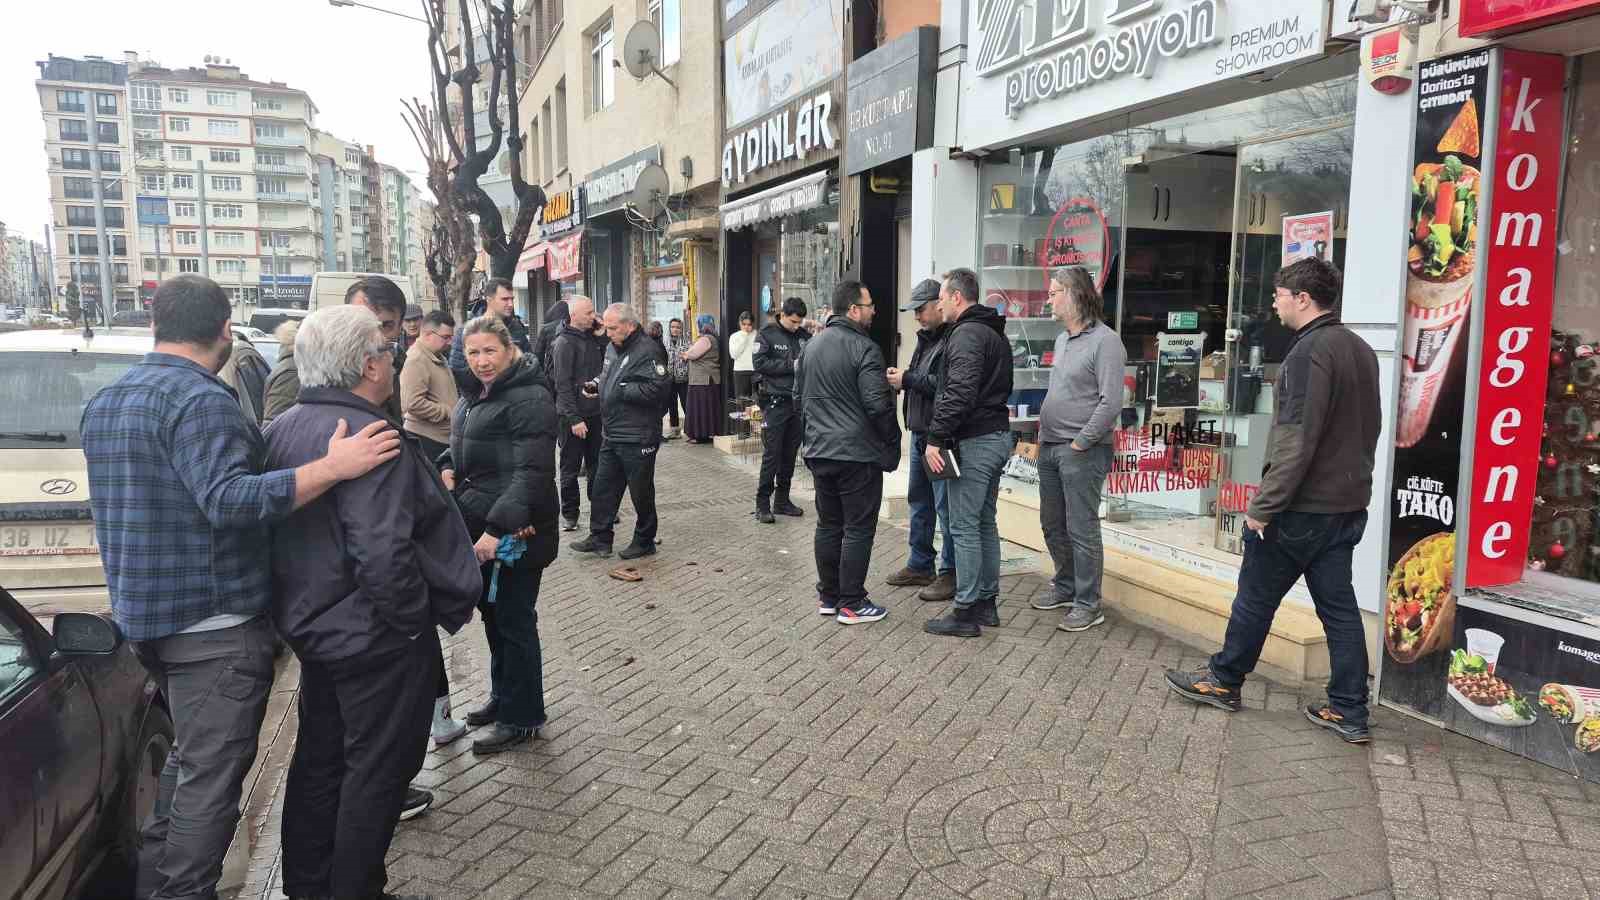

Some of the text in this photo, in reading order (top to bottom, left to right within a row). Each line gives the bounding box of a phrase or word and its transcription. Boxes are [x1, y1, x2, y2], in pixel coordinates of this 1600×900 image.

[1230, 15, 1299, 51] PREMIUM
[1004, 1, 1217, 118] promosyon
[1215, 33, 1314, 76] SHOWROOM
[1421, 51, 1489, 80] DÜRÜMÜNÜ
[1420, 74, 1475, 95] Doritos'la
[722, 90, 834, 187] AYDINLAR
[1480, 77, 1543, 560] komagene
[1168, 338, 1194, 347] contigo
[1151, 419, 1217, 447] PLAKET
[1397, 488, 1454, 526] TAKO
